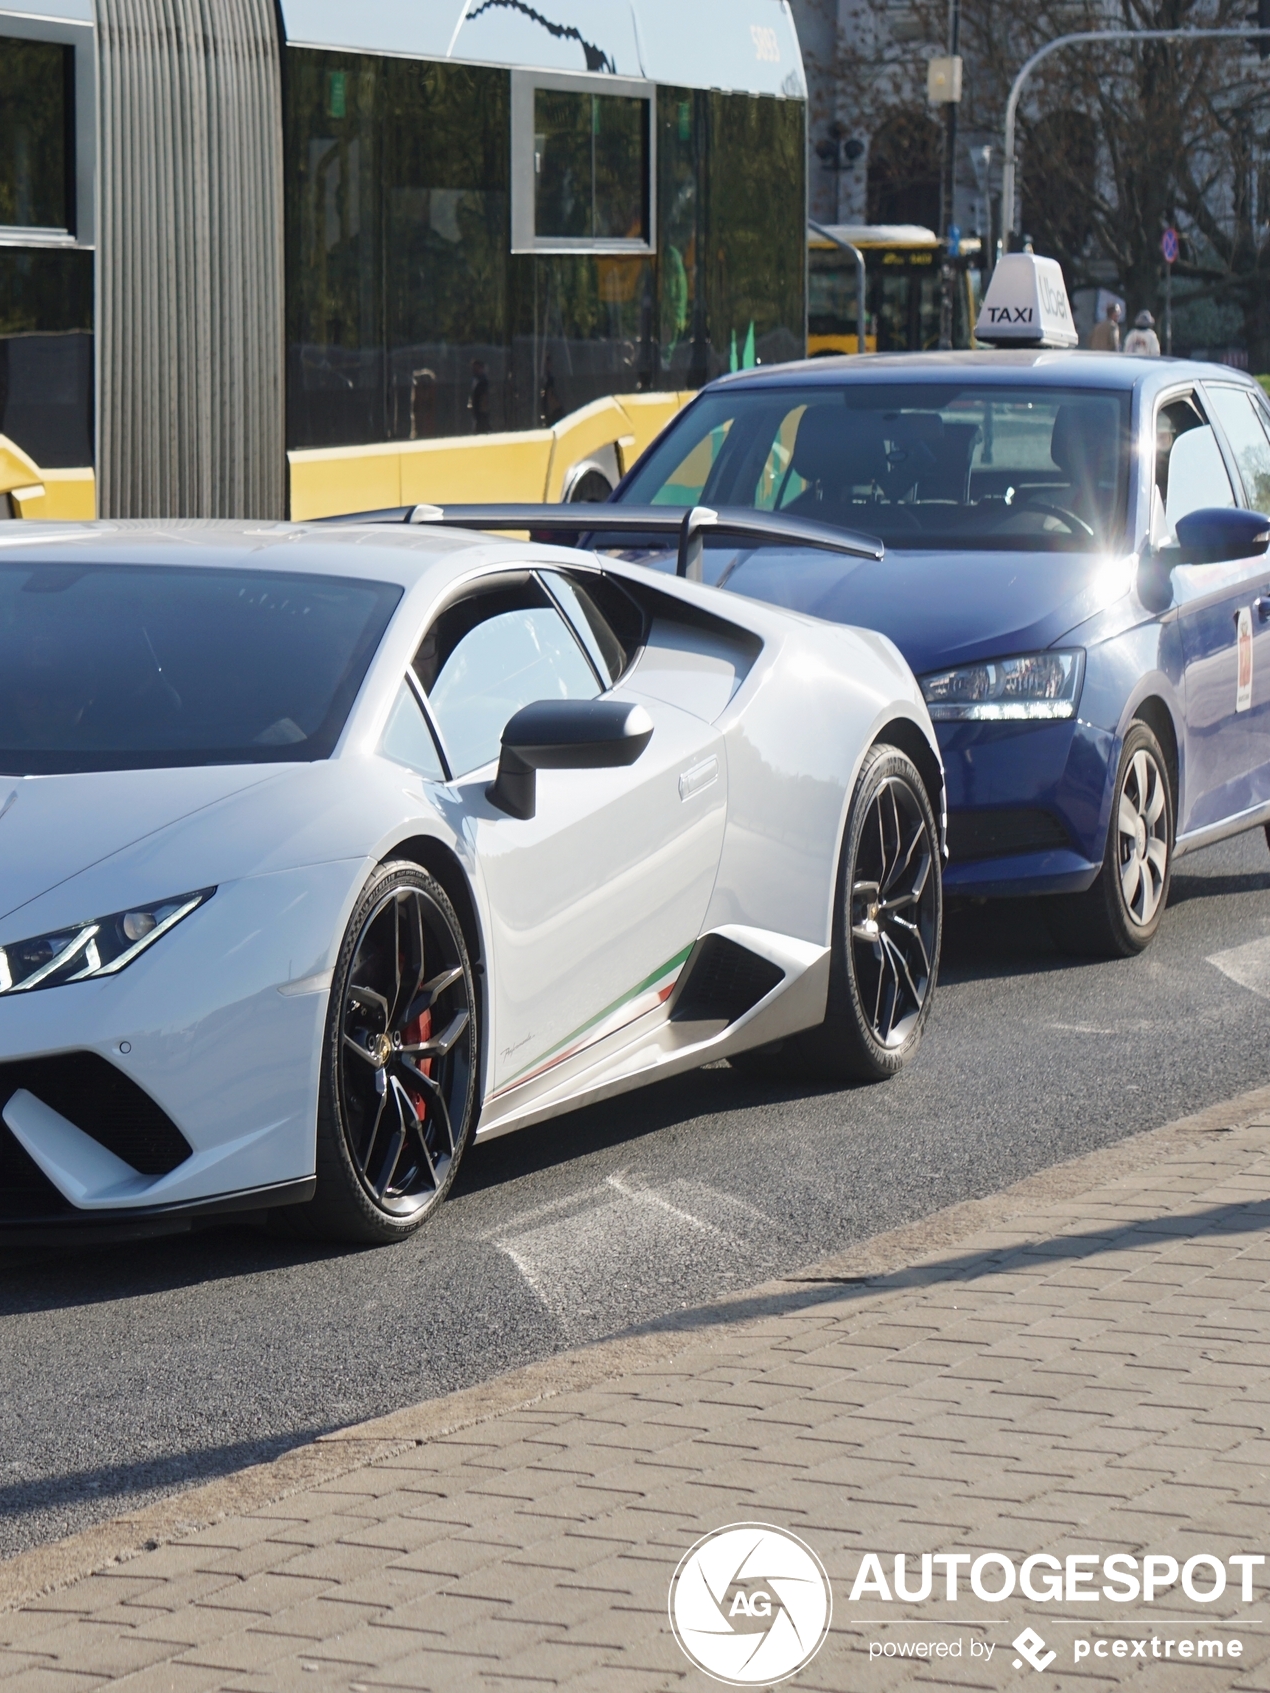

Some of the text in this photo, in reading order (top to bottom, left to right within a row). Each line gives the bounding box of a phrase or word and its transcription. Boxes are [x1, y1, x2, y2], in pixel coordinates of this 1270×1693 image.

[1038, 274, 1068, 320] Uber
[987, 306, 1033, 323] TAXI
[368, 873, 396, 904] MICHELIN
